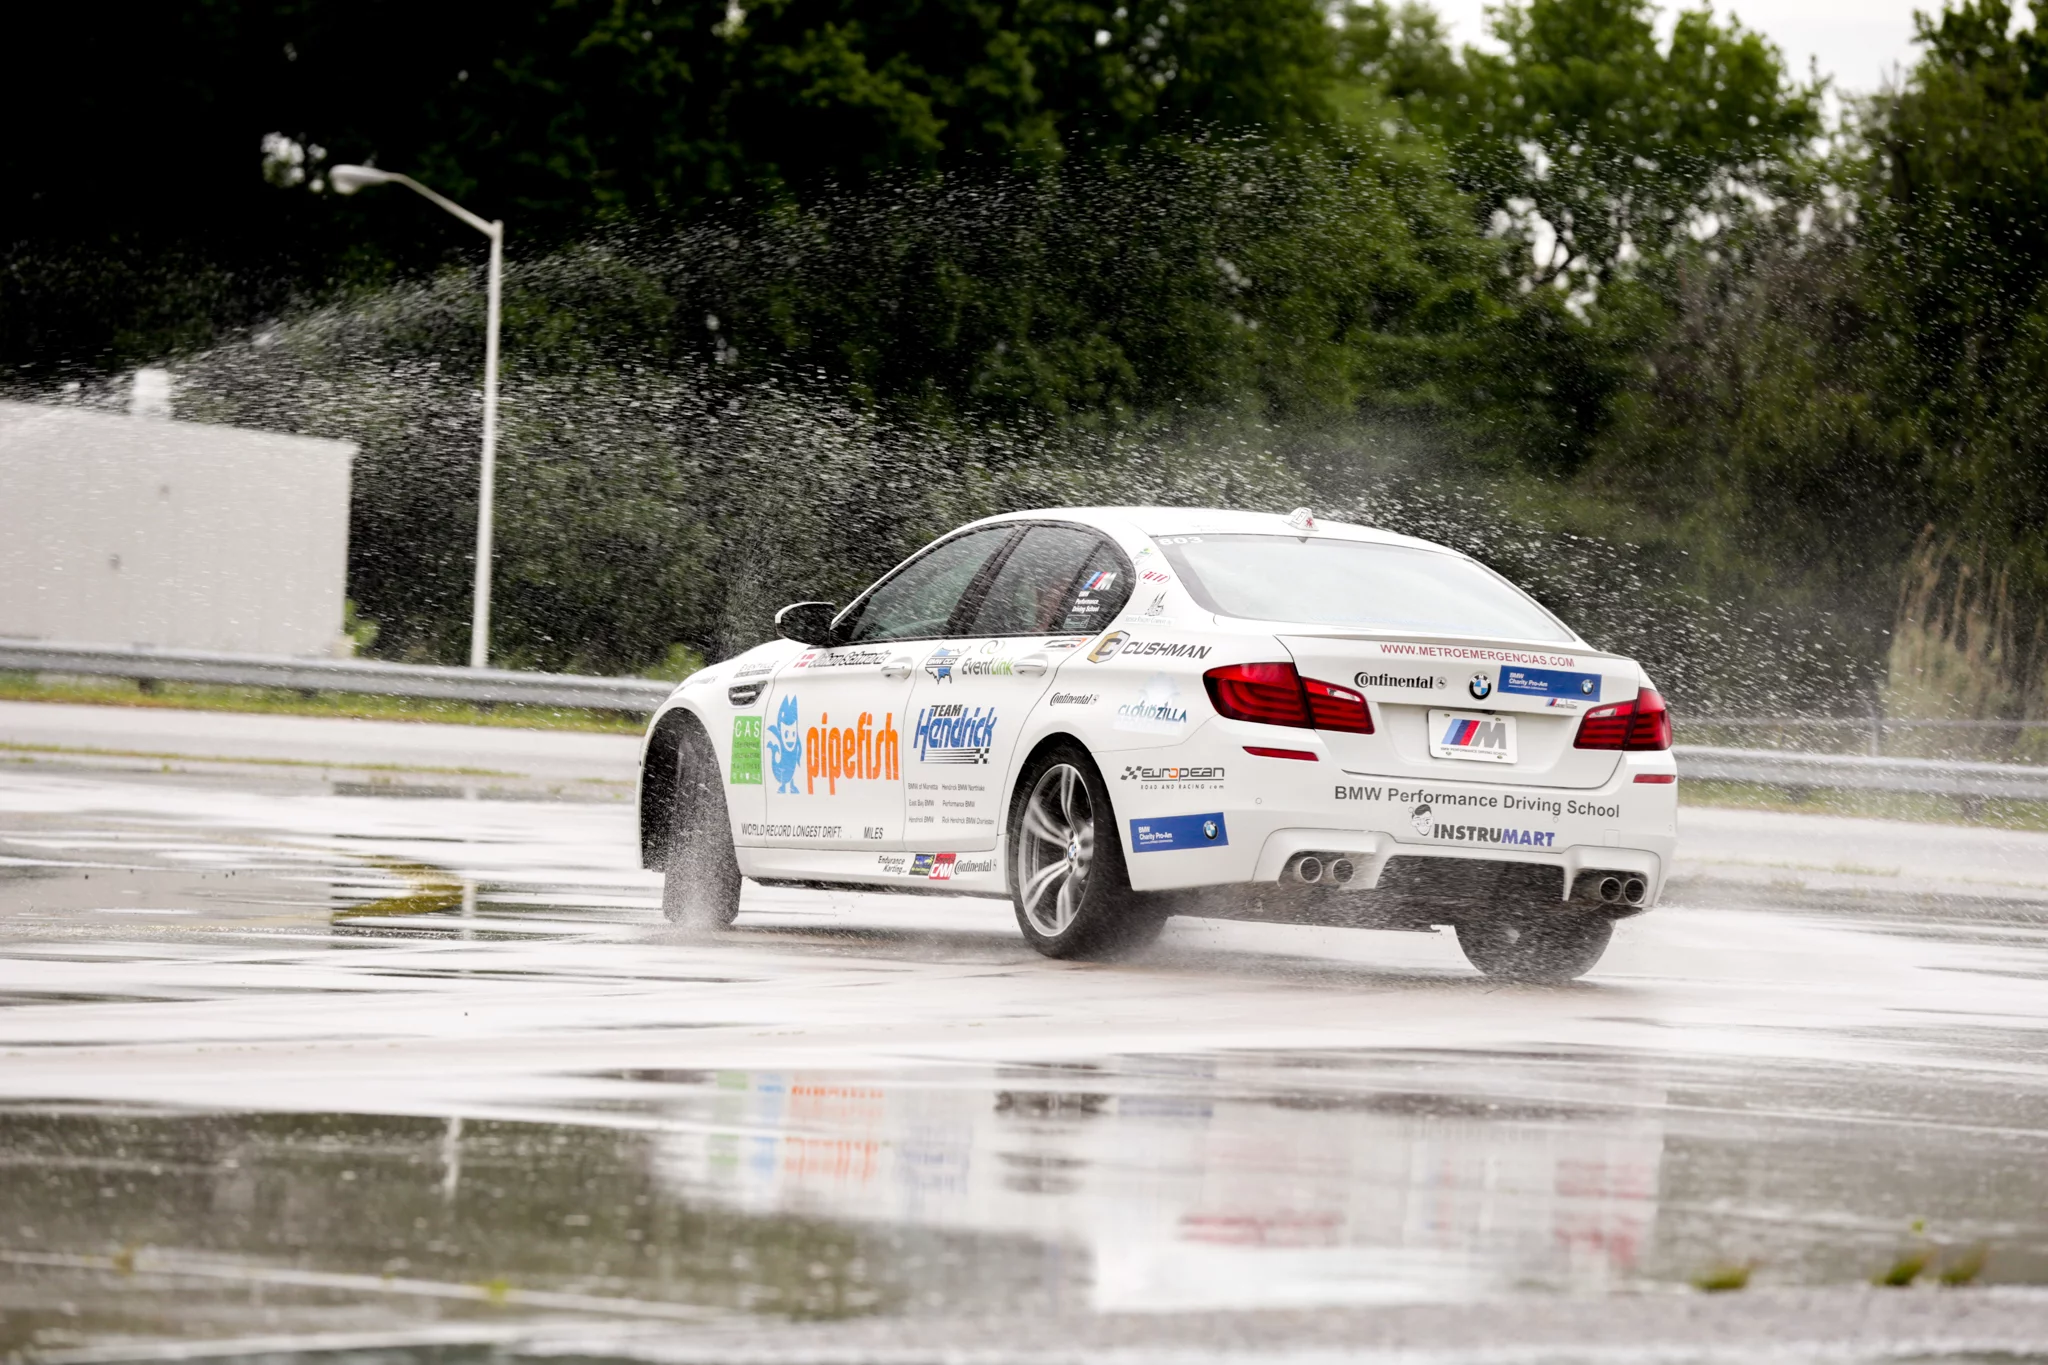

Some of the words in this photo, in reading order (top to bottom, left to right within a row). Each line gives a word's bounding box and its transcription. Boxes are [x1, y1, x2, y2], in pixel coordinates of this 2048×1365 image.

[1158, 536, 1203, 545] 803
[1121, 641, 1212, 659] CUSHMAN
[1380, 644, 1575, 667] WWW.METROEMERGENCIAS.COM
[1354, 672, 1434, 689] Continental
[1508, 678, 1528, 686] Charity
[1050, 692, 1093, 706] Continental
[931, 704, 963, 717] TEAM
[1117, 700, 1187, 723] CLOUDZILLA
[913, 707, 997, 762] Hendrick
[806, 711, 899, 795] pipefish
[1335, 785, 1382, 801] BMW
[1387, 787, 1498, 808] Performance
[1503, 795, 1562, 816] Driving
[1566, 799, 1620, 818] School
[741, 822, 765, 836] WORLD
[765, 824, 791, 837] RECORD
[792, 825, 822, 838] LONGEST
[863, 826, 884, 839] MILES
[1433, 823, 1555, 846] INSTRUMART
[878, 855, 905, 865] Endurance
[954, 858, 993, 875] Continental
